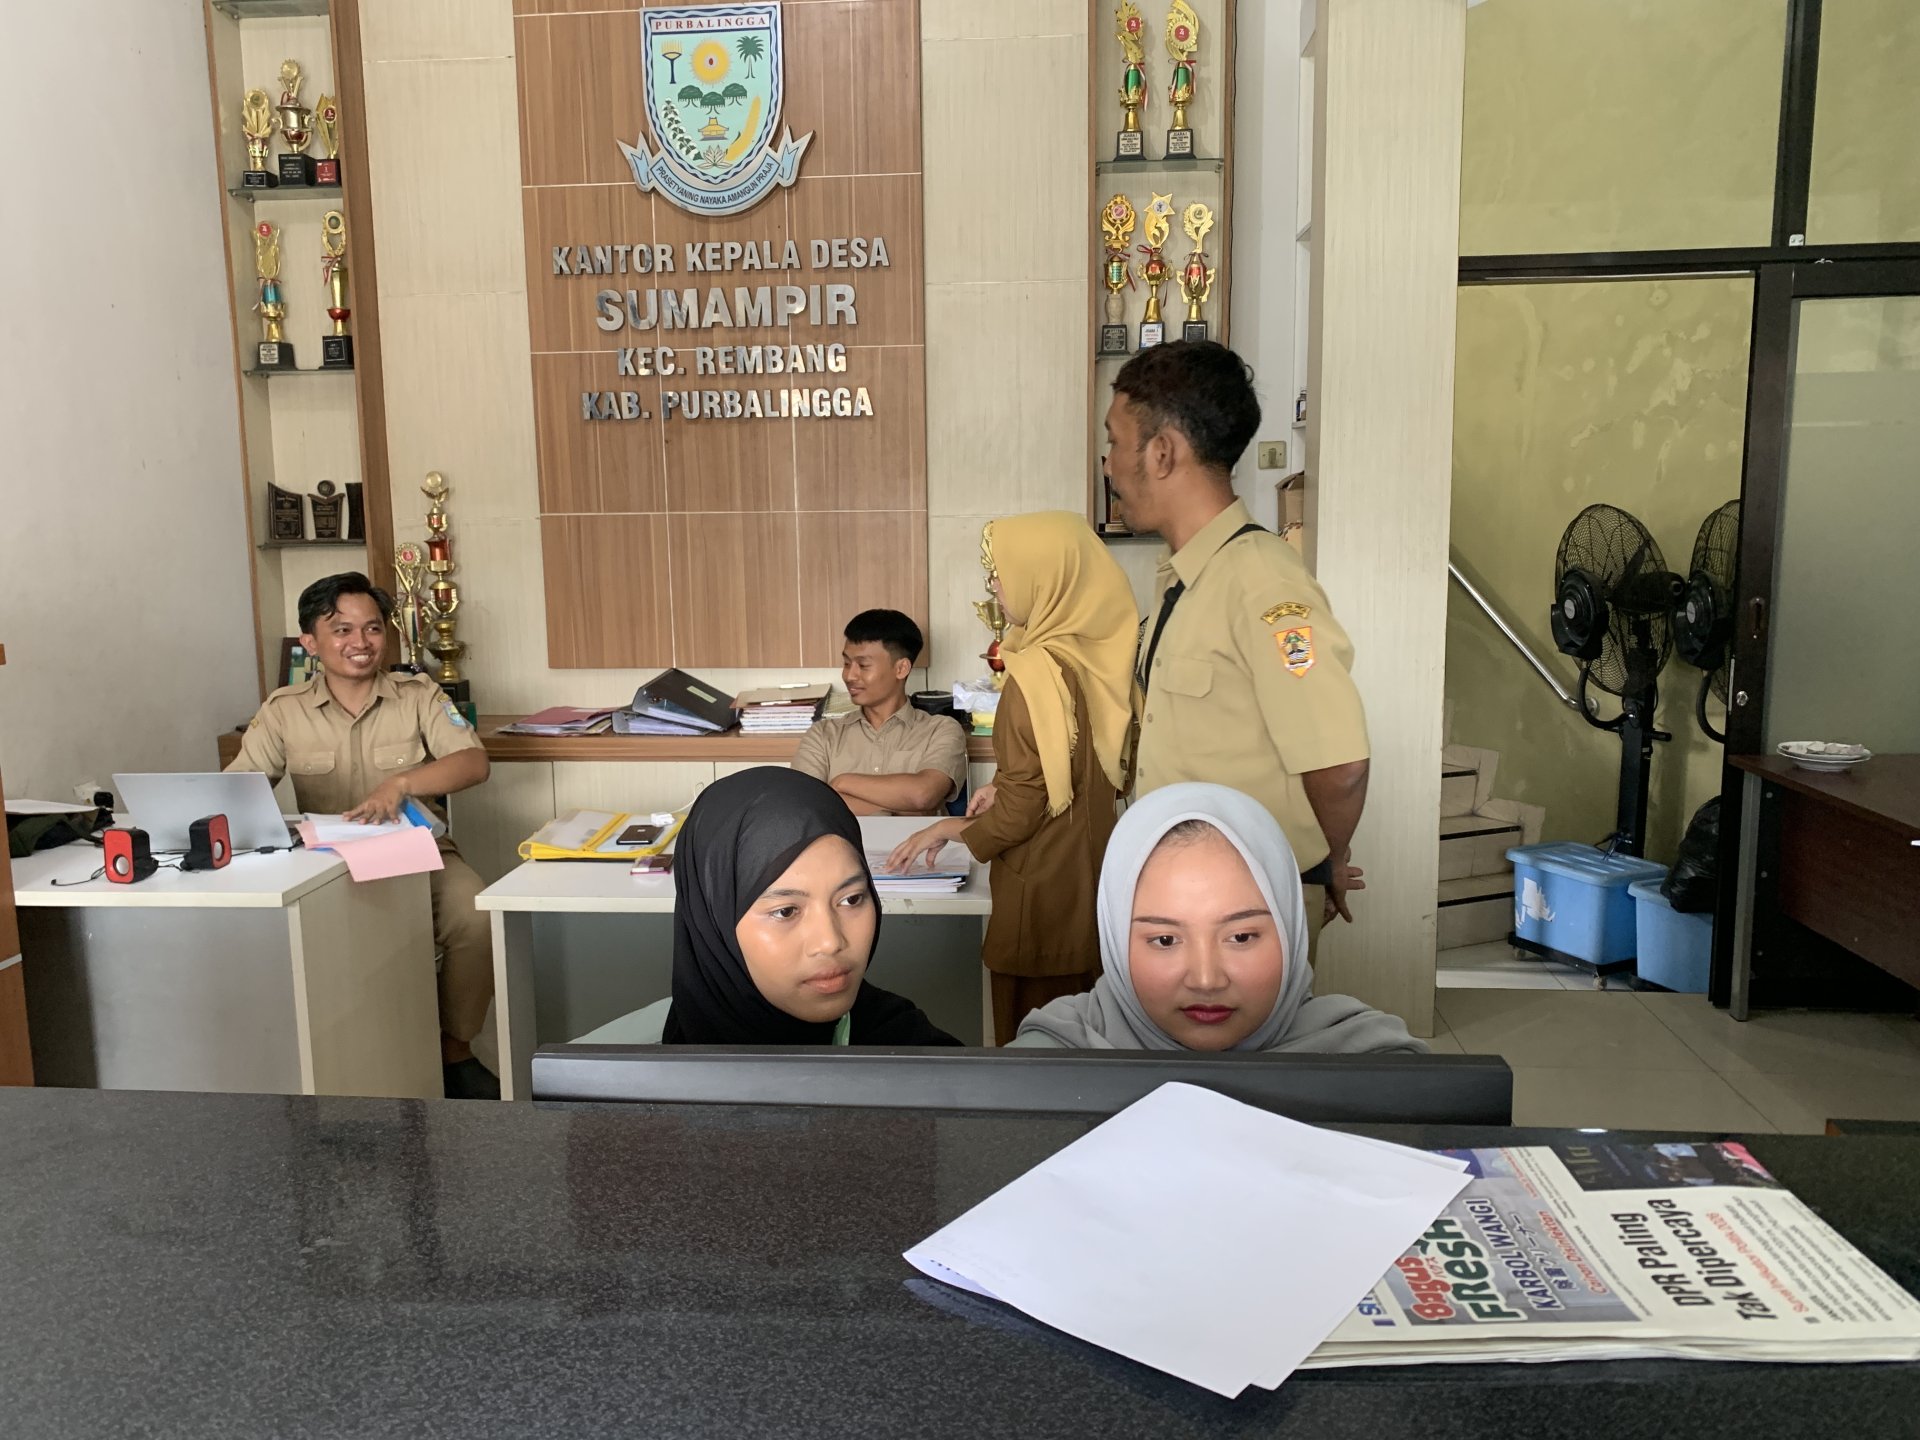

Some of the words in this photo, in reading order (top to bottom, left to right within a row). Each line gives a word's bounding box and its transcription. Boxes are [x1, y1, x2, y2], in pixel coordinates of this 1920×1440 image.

[655, 16, 766, 30] PURBALINGGA
[656, 166, 699, 202] PRASETYANING
[700, 195, 727, 205] NAYAKA
[727, 182, 758, 203] AMANGUN
[757, 162, 774, 185] PRAJA
[553, 243, 675, 275] KANTOR
[686, 240, 801, 272] KEPALA
[811, 237, 890, 268] DESA
[595, 284, 858, 332] SUMAMPIR
[618, 347, 686, 376] KEC.
[697, 343, 847, 375] REMBANG
[582, 391, 651, 420] KAB.
[663, 387, 873, 419] PURBALINGGA
[1466, 1200, 1516, 1248] WANGI
[1611, 1213, 1677, 1269] Paling
[1648, 1199, 1745, 1287] Dipercaya
[1500, 1251, 1562, 1309] KARBOL
[1652, 1273, 1715, 1307] DPR
[1722, 1291, 1778, 1321] Tak
